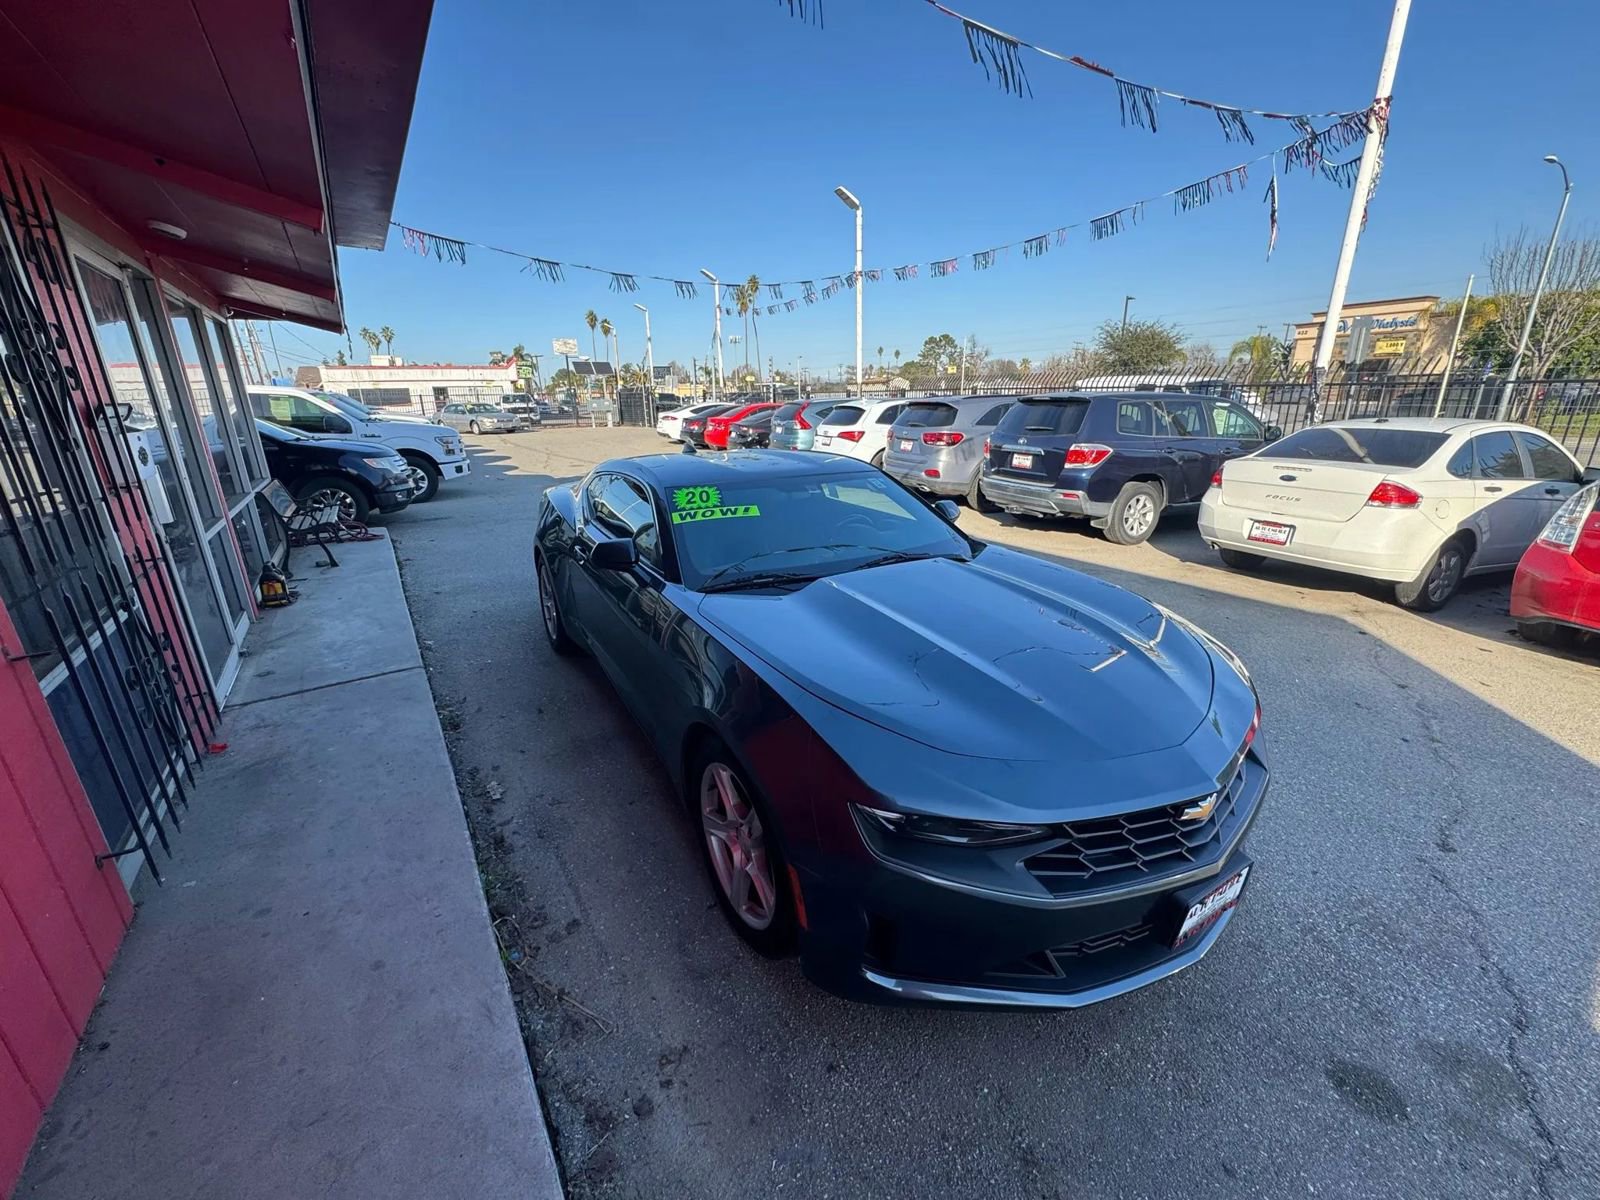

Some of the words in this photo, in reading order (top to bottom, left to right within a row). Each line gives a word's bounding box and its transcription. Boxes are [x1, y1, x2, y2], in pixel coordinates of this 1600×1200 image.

[685, 490, 711, 505] 20
[1265, 494, 1302, 502] FOCUS
[678, 507, 751, 521] WOW!
